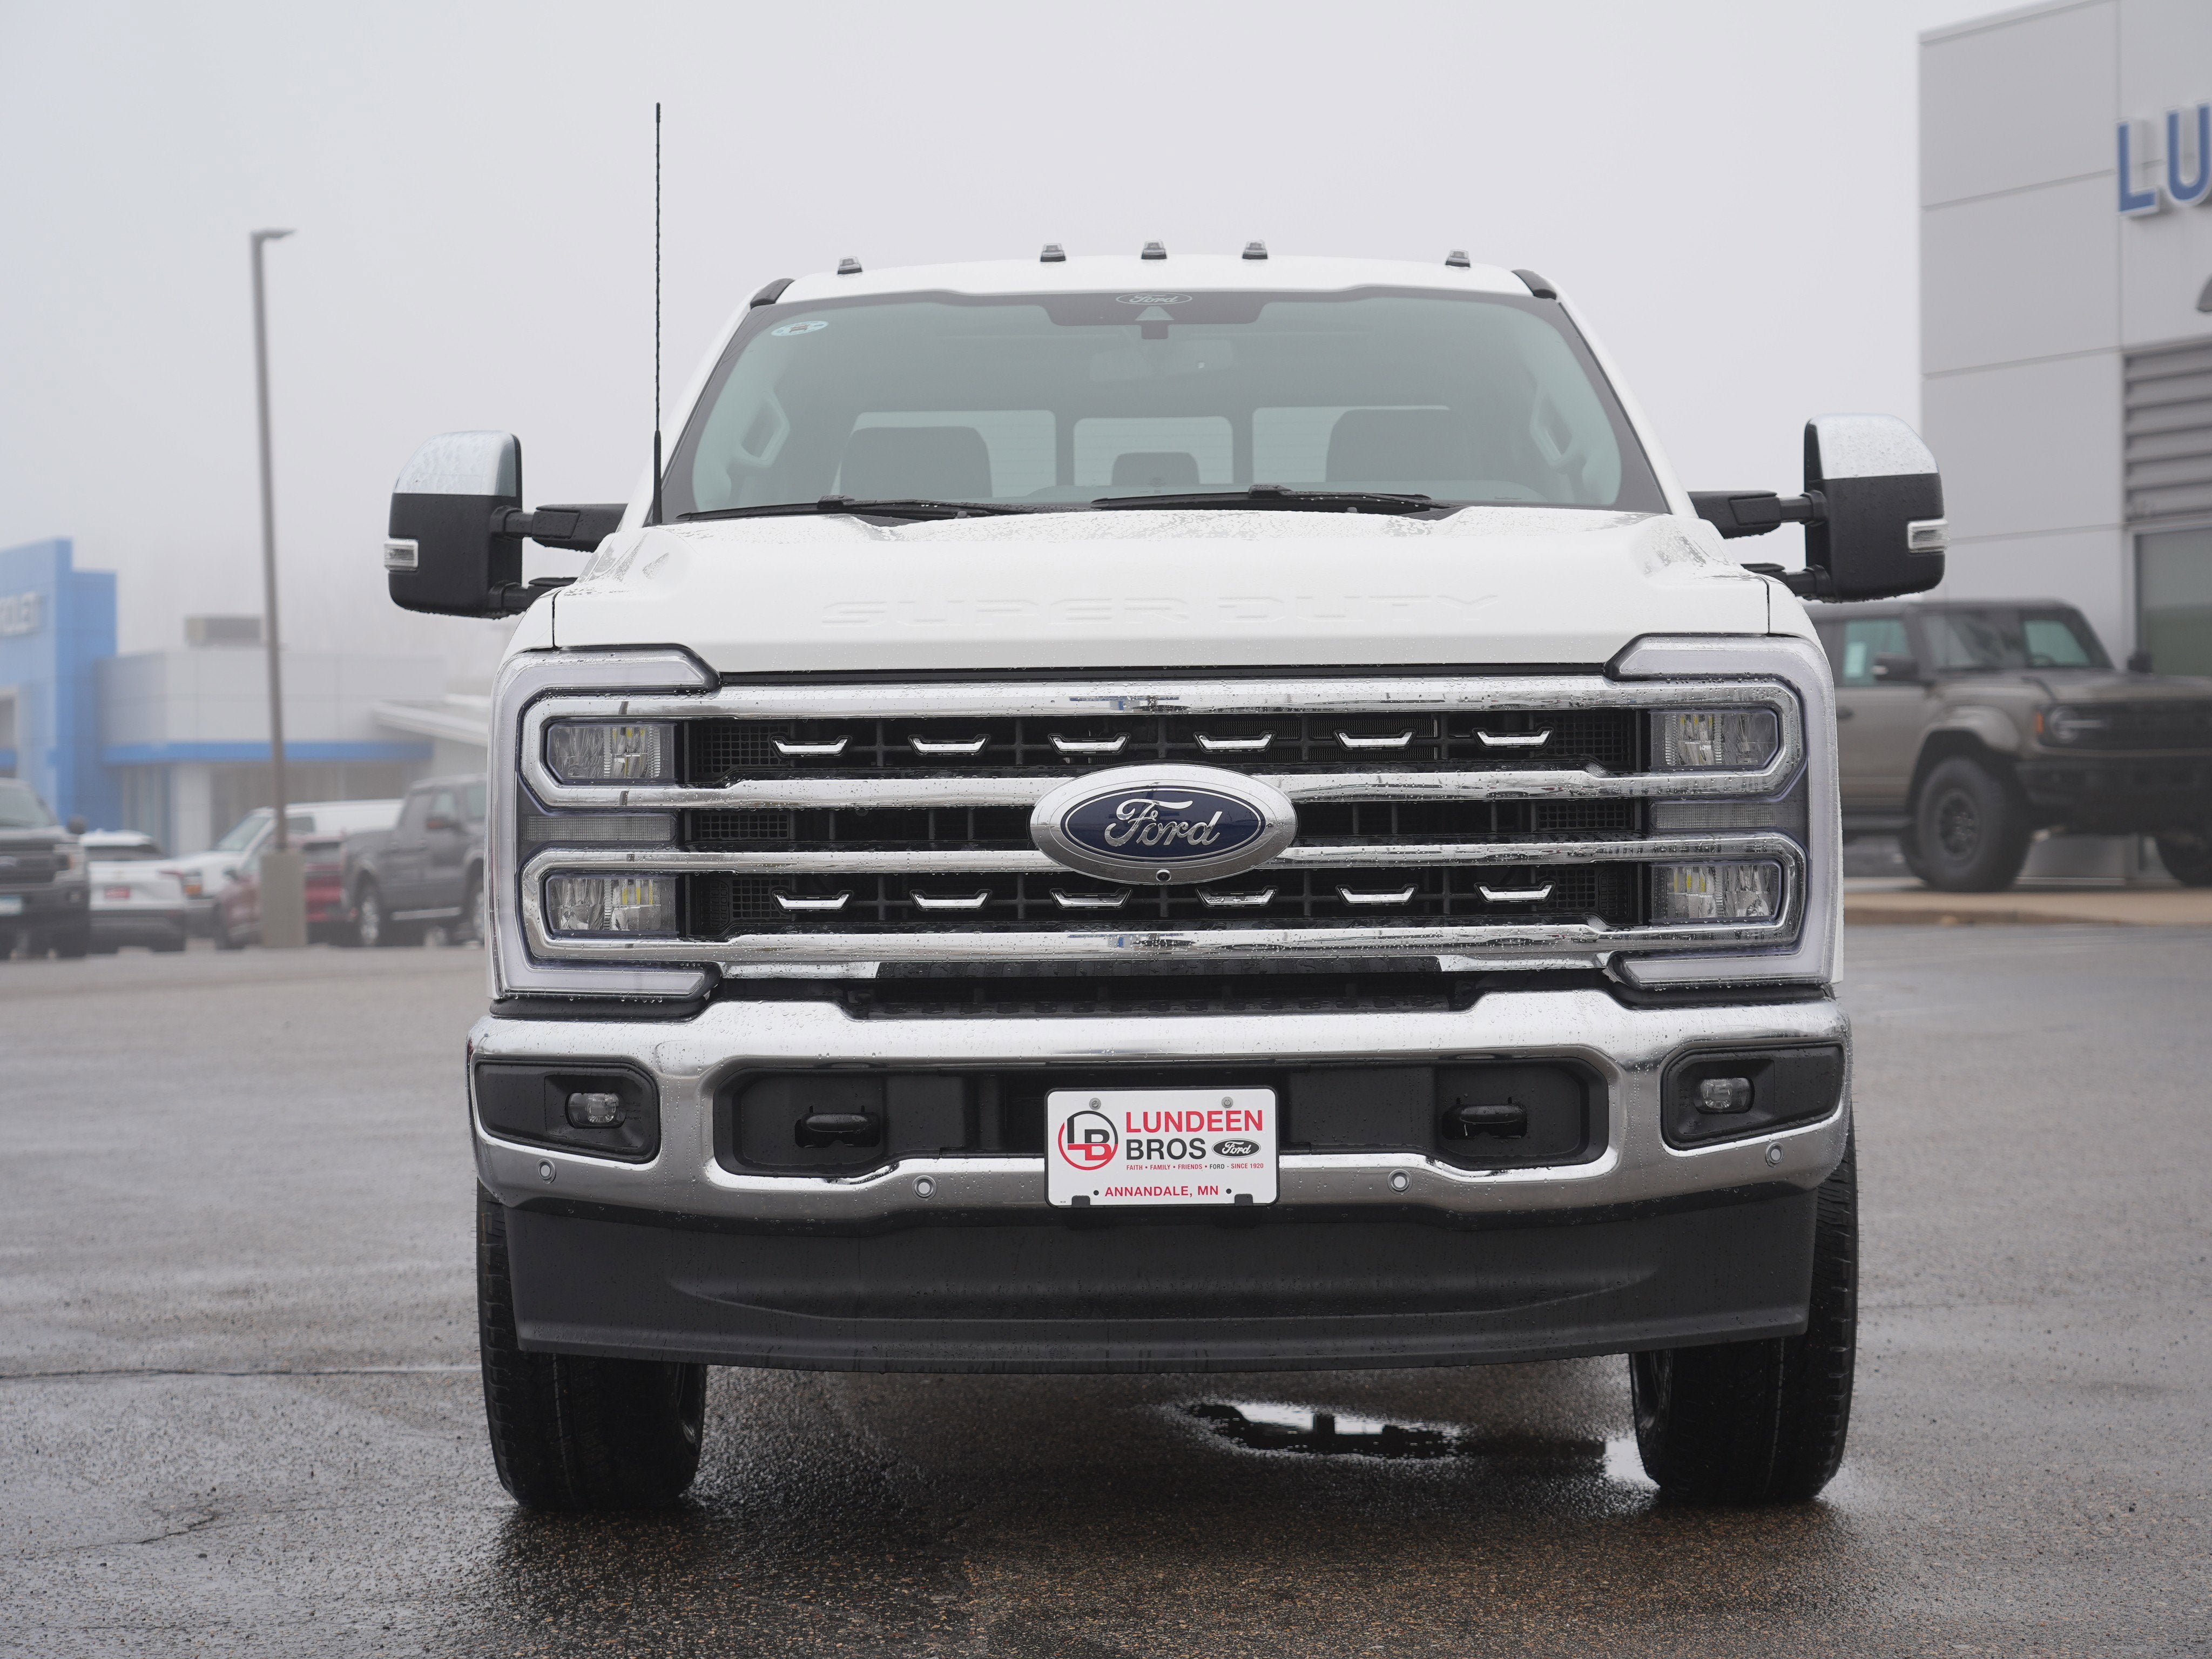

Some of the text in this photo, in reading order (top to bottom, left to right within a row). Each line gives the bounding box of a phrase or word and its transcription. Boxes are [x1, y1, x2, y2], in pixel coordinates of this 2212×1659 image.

[1129, 294, 1179, 303] Ford
[820, 595, 1499, 628] SUPER DUTY
[1104, 798, 1223, 847] Ford
[1126, 1110, 1263, 1133] LUNDEEN
[1126, 1138, 1206, 1160] BROS
[1222, 1141, 1251, 1155] Ford
[1104, 1185, 1219, 1198] ANNANDALE, MN
